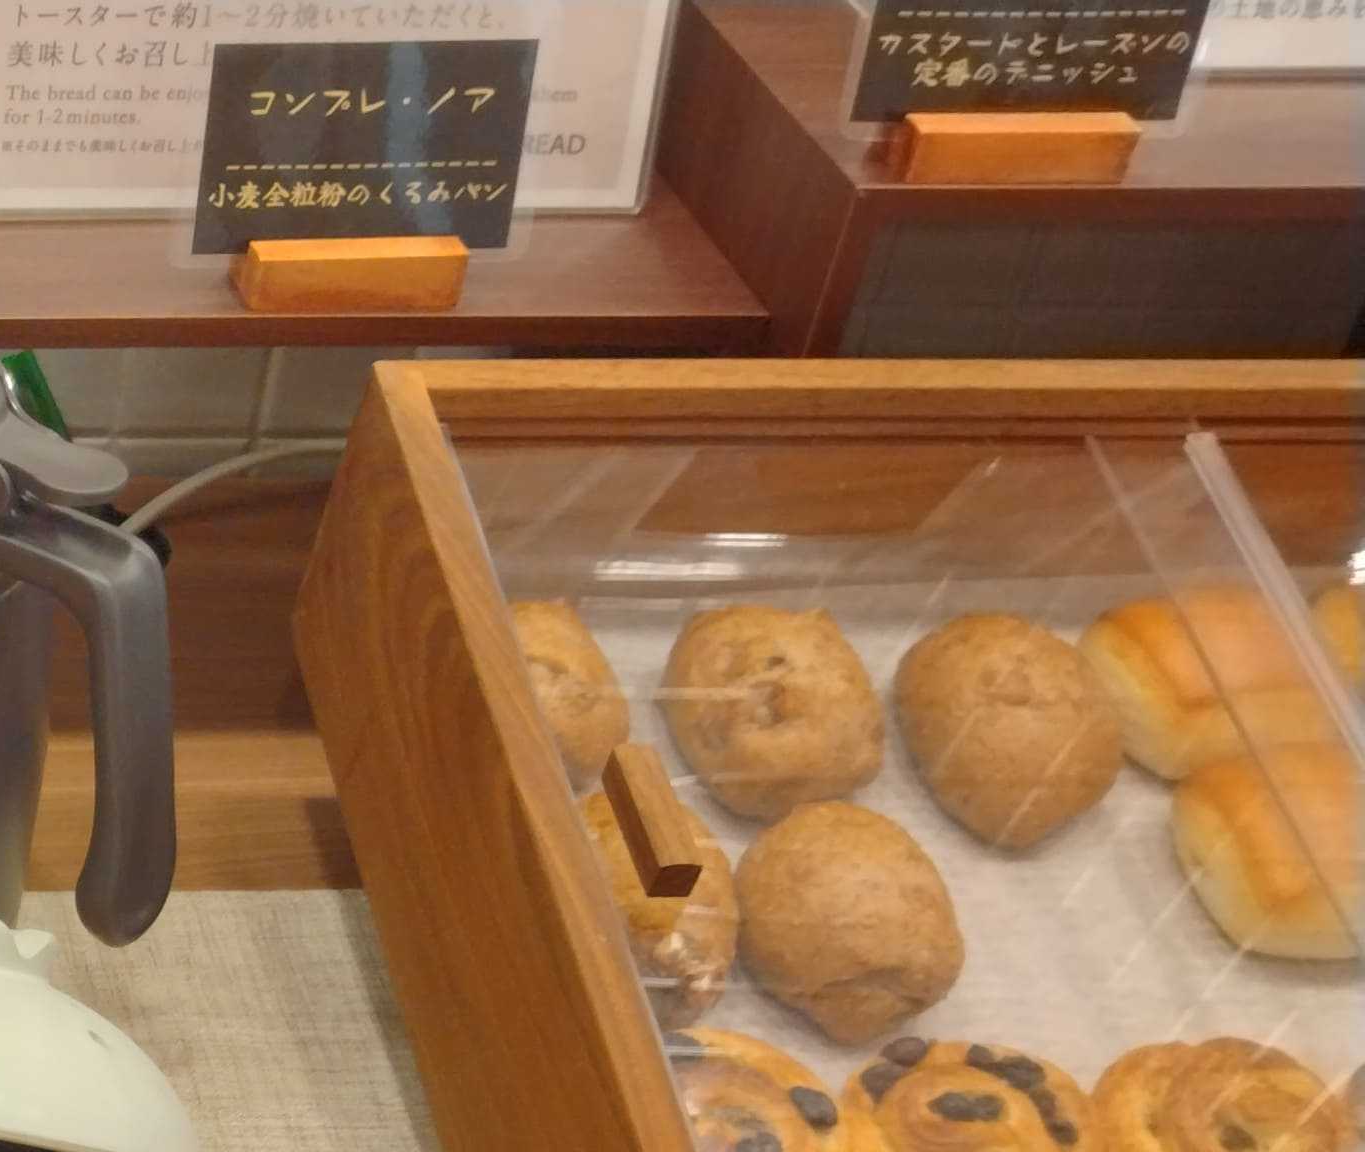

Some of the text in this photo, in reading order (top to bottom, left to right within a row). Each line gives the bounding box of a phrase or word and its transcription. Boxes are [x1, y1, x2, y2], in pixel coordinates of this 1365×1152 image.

[911, 59, 1139, 88] 定番のデニッシュ
[6, 84, 209, 104] The bread can be enjo
[4, 109, 30, 125] for
[208, 181, 508, 208] 小麦全粒粉のくるみパン
